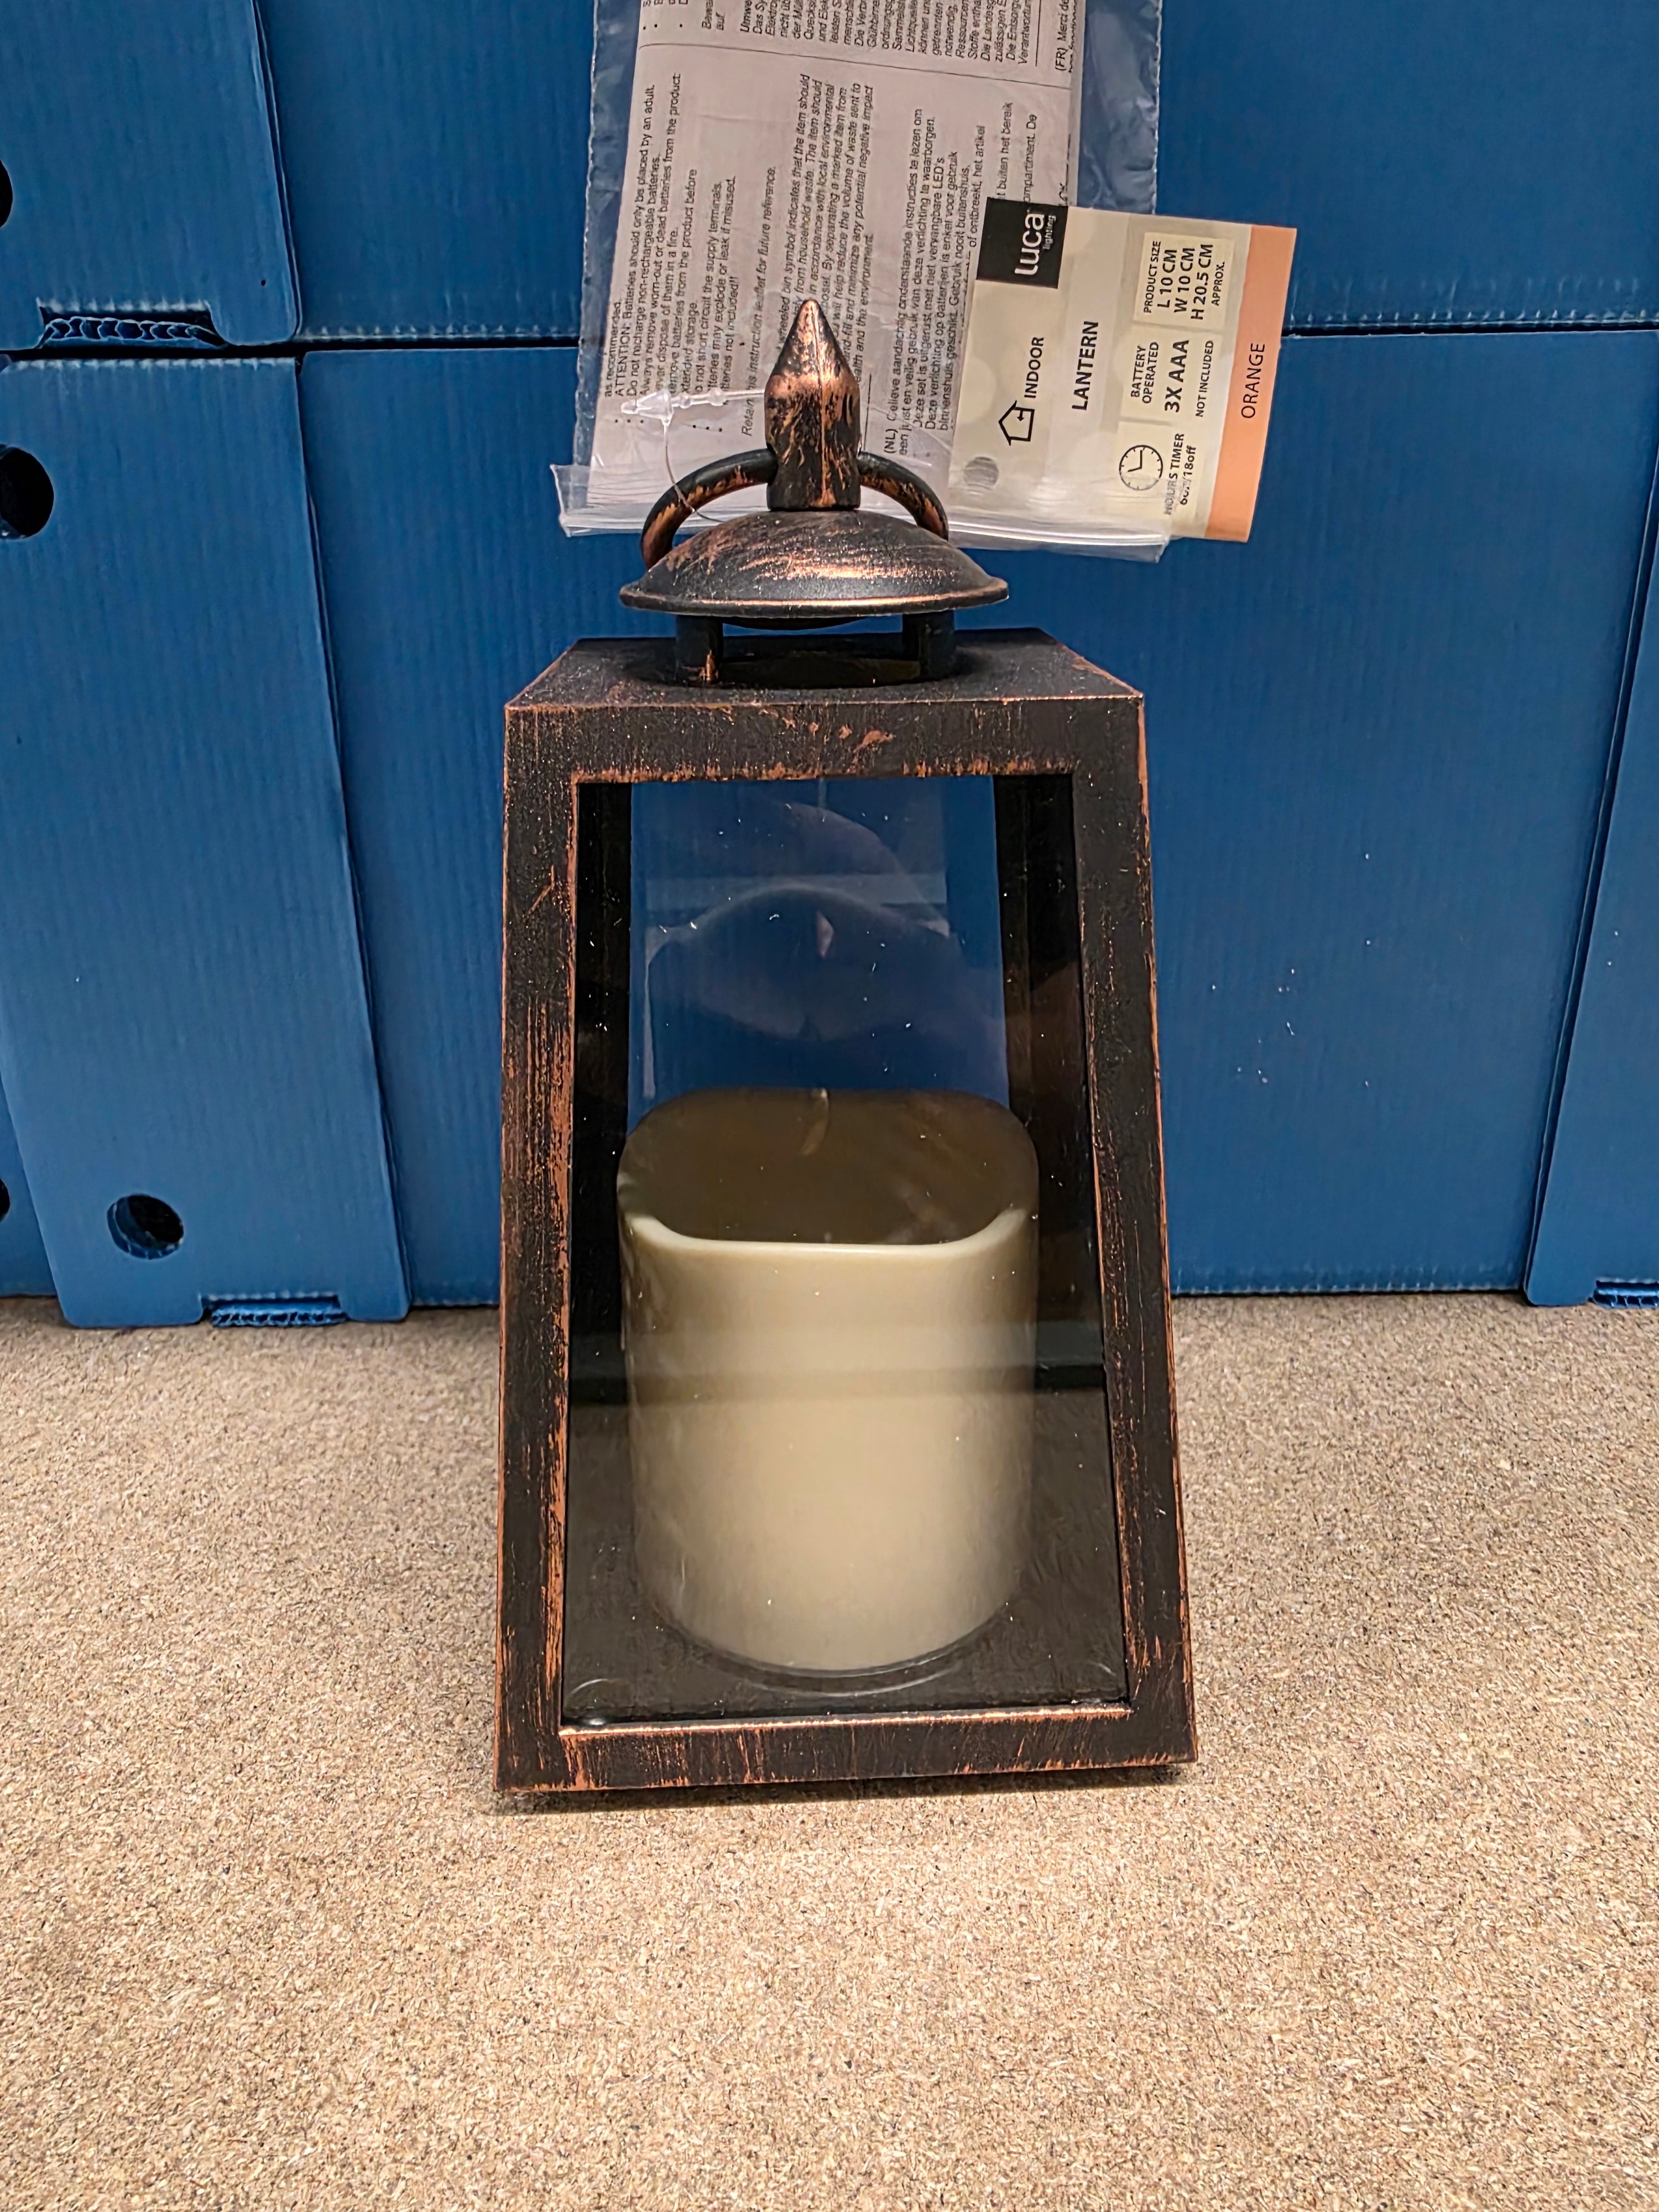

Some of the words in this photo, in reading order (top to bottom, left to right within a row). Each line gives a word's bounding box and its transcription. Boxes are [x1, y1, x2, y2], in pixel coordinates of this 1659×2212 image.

[753, 14, 764, 34] Das
[1055, 48, 1068, 71] (FR)
[798, 74, 810, 109] should
[811, 79, 822, 116] should
[851, 83, 861, 93] to
[643, 117, 651, 131] an
[666, 119, 676, 135] the
[796, 112, 806, 135] item
[808, 118, 818, 140] item
[914, 109, 922, 126] om
[1026, 114, 1037, 129] De
[640, 134, 653, 147] by
[794, 138, 804, 155] the
[848, 122, 857, 152] waste
[910, 129, 921, 157] lezen
[1000, 137, 1010, 154] het
[662, 138, 674, 162] from
[805, 144, 817, 163] The
[844, 153, 854, 165] of
[637, 149, 648, 185] placed
[792, 156, 802, 178] that
[816, 161, 828, 186] local
[909, 160, 919, 170] te
[658, 166, 671, 212] batteries
[685, 169, 697, 204] before
[822, 255, 834, 271] By
[836, 87, 847, 111] from
[841, 168, 853, 207] volume
[920, 184, 930, 194] te
[634, 188, 645, 202] be
[787, 181, 800, 229] indicates
[816, 190, 825, 212] with
[855, 171, 866, 218] potential
[946, 193, 954, 217] voor
[967, 236, 977, 248] of
[972, 160, 983, 177] het
[633, 206, 645, 228] only
[682, 207, 693, 248] product
[838, 212, 849, 229] the
[656, 216, 667, 243] dead
[758, 223, 770, 256] future
[853, 221, 864, 242] any
[1042, 215, 1056, 249] lighting
[629, 231, 640, 267] should
[655, 246, 663, 257] or
[718, 237, 729, 260] leak
[784, 233, 796, 274] symbol
[836, 233, 848, 272] reduce
[1015, 213, 1044, 275] luca
[1150, 241, 1161, 263] SIZE
[1198, 244, 1213, 268] CM
[679, 251, 689, 268] the
[719, 263, 727, 275] or
[755, 260, 767, 274] for
[940, 254, 950, 263] is
[1162, 249, 1177, 273] CM
[1180, 248, 1195, 272] CM
[794, 267, 806, 294] from
[912, 258, 924, 285] deze
[926, 265, 936, 285] niet
[675, 272, 686, 297] from
[832, 274, 846, 299] help
[1144, 264, 1157, 313] PRODUCT
[1159, 277, 1173, 295] 10
[1177, 275, 1191, 293] 10
[1193, 272, 1209, 305] 20.5
[1211, 262, 1225, 306] APPROX.
[661, 304, 671, 316] of
[911, 289, 921, 309] van
[925, 289, 934, 310] met
[1157, 300, 1171, 308] L
[1173, 298, 1188, 313] W
[671, 300, 685, 348] batteries
[1191, 309, 1204, 320] H
[633, 307, 646, 356] recharge
[645, 312, 658, 353] remove
[696, 364, 705, 382] not
[702, 275, 713, 293] the
[712, 326, 723, 350] may
[935, 322, 946, 336] op
[656, 320, 670, 362] dispose
[725, 334, 734, 352] not
[615, 324, 631, 397] ATTENTION:
[630, 360, 640, 377] not
[916, 366, 927, 375] is
[1024, 337, 1044, 398] INDOOR
[1072, 321, 1098, 410] LANTERN
[1130, 346, 1146, 398] BATTERY
[1168, 340, 1189, 382] AAA
[1199, 341, 1214, 393] INCLUDED
[1142, 342, 1159, 404] OPERATED
[1241, 343, 1265, 418] ORANGE
[627, 380, 638, 396] Do
[904, 390, 912, 405] en
[916, 378, 927, 395] set
[1164, 387, 1182, 413] 3X
[1195, 394, 1206, 417] NOT
[741, 398, 755, 436] Retain
[925, 400, 938, 430] Deze
[884, 429, 898, 453] (NL)
[1170, 434, 1185, 469] TIMER
